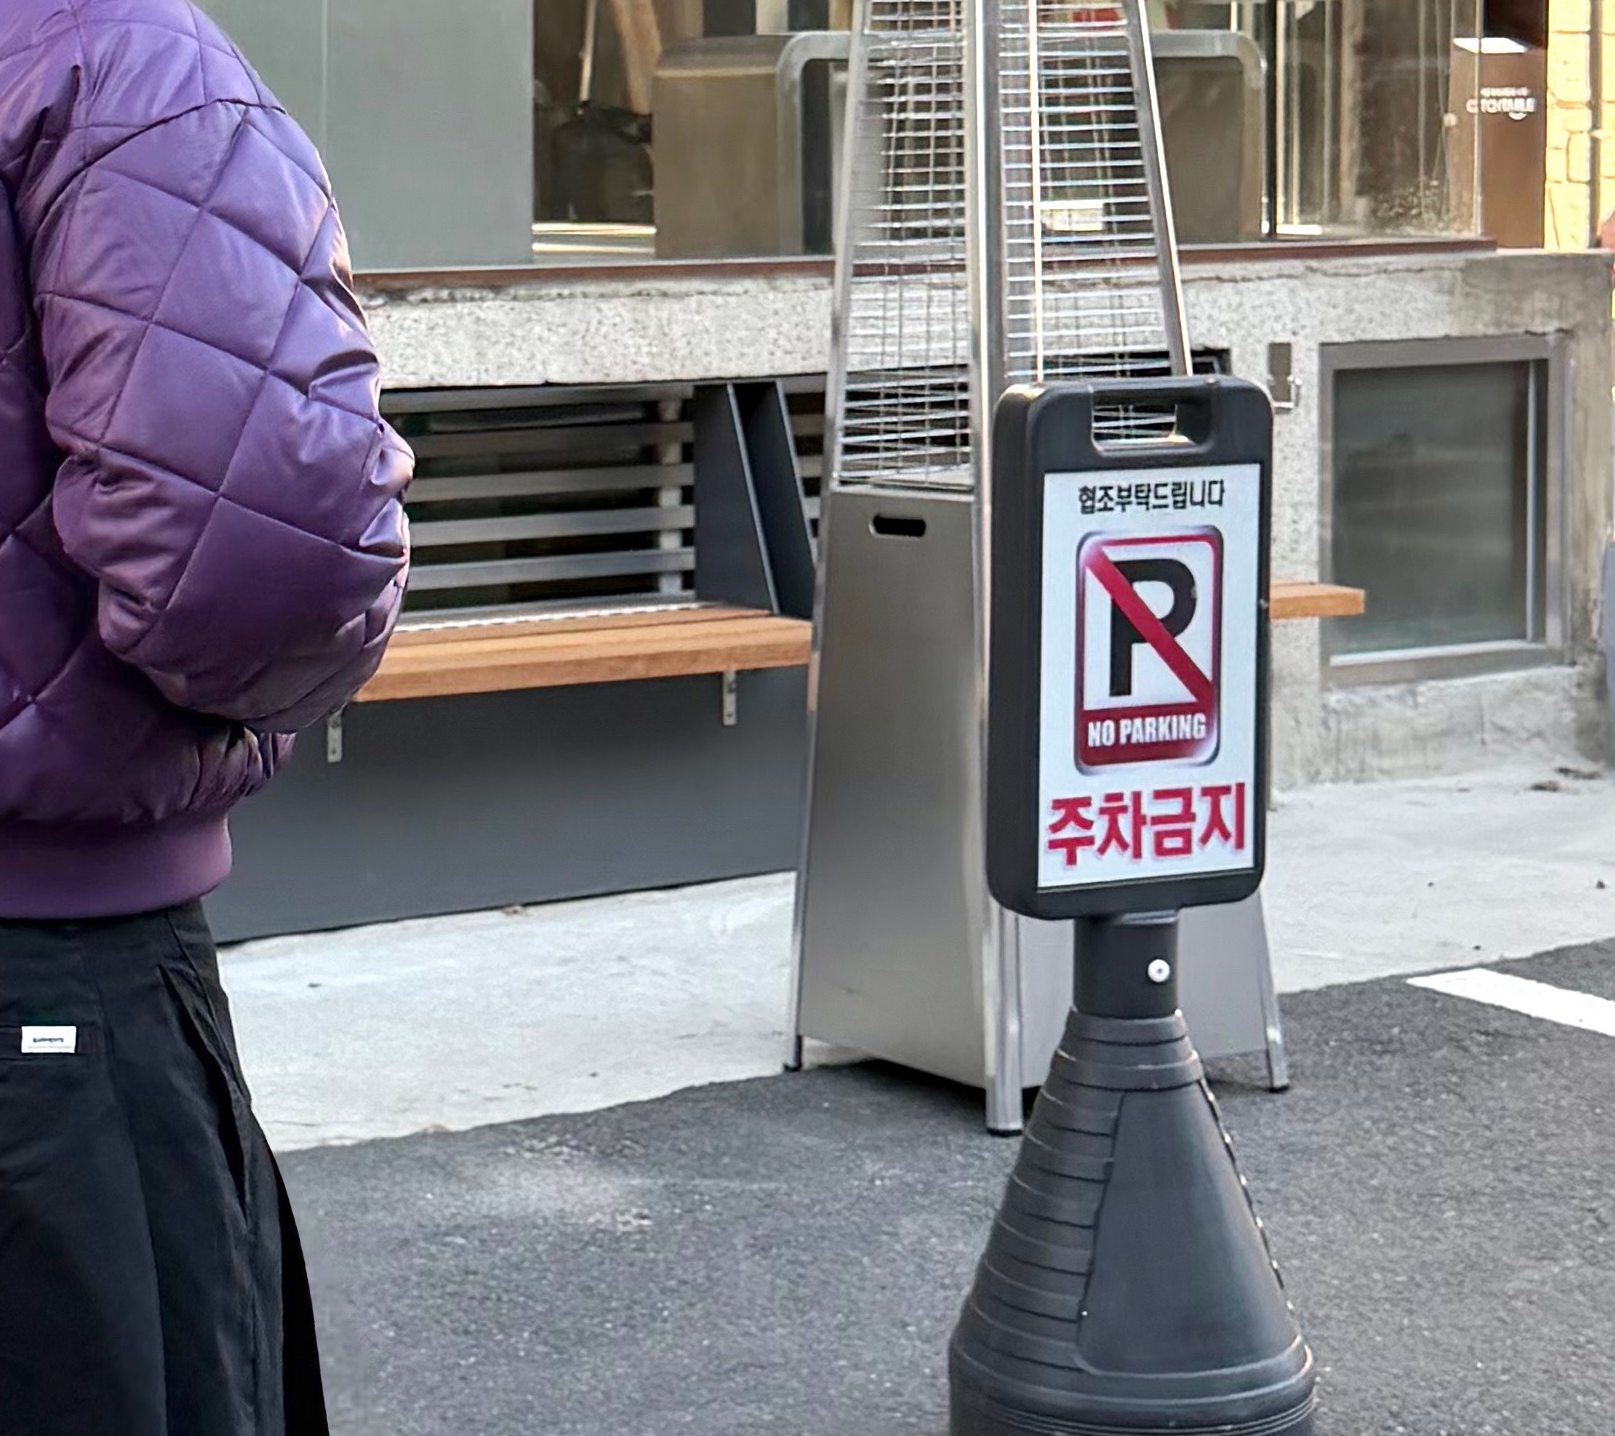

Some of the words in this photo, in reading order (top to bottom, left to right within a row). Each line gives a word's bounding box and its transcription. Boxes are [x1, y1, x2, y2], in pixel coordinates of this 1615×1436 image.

[1079, 479, 1225, 514] 협조부탁드립니다
[1109, 558, 1197, 697] P
[1088, 720, 1115, 747] NO
[1119, 713, 1206, 744] PARKING
[1048, 782, 1245, 866] 주차금지
